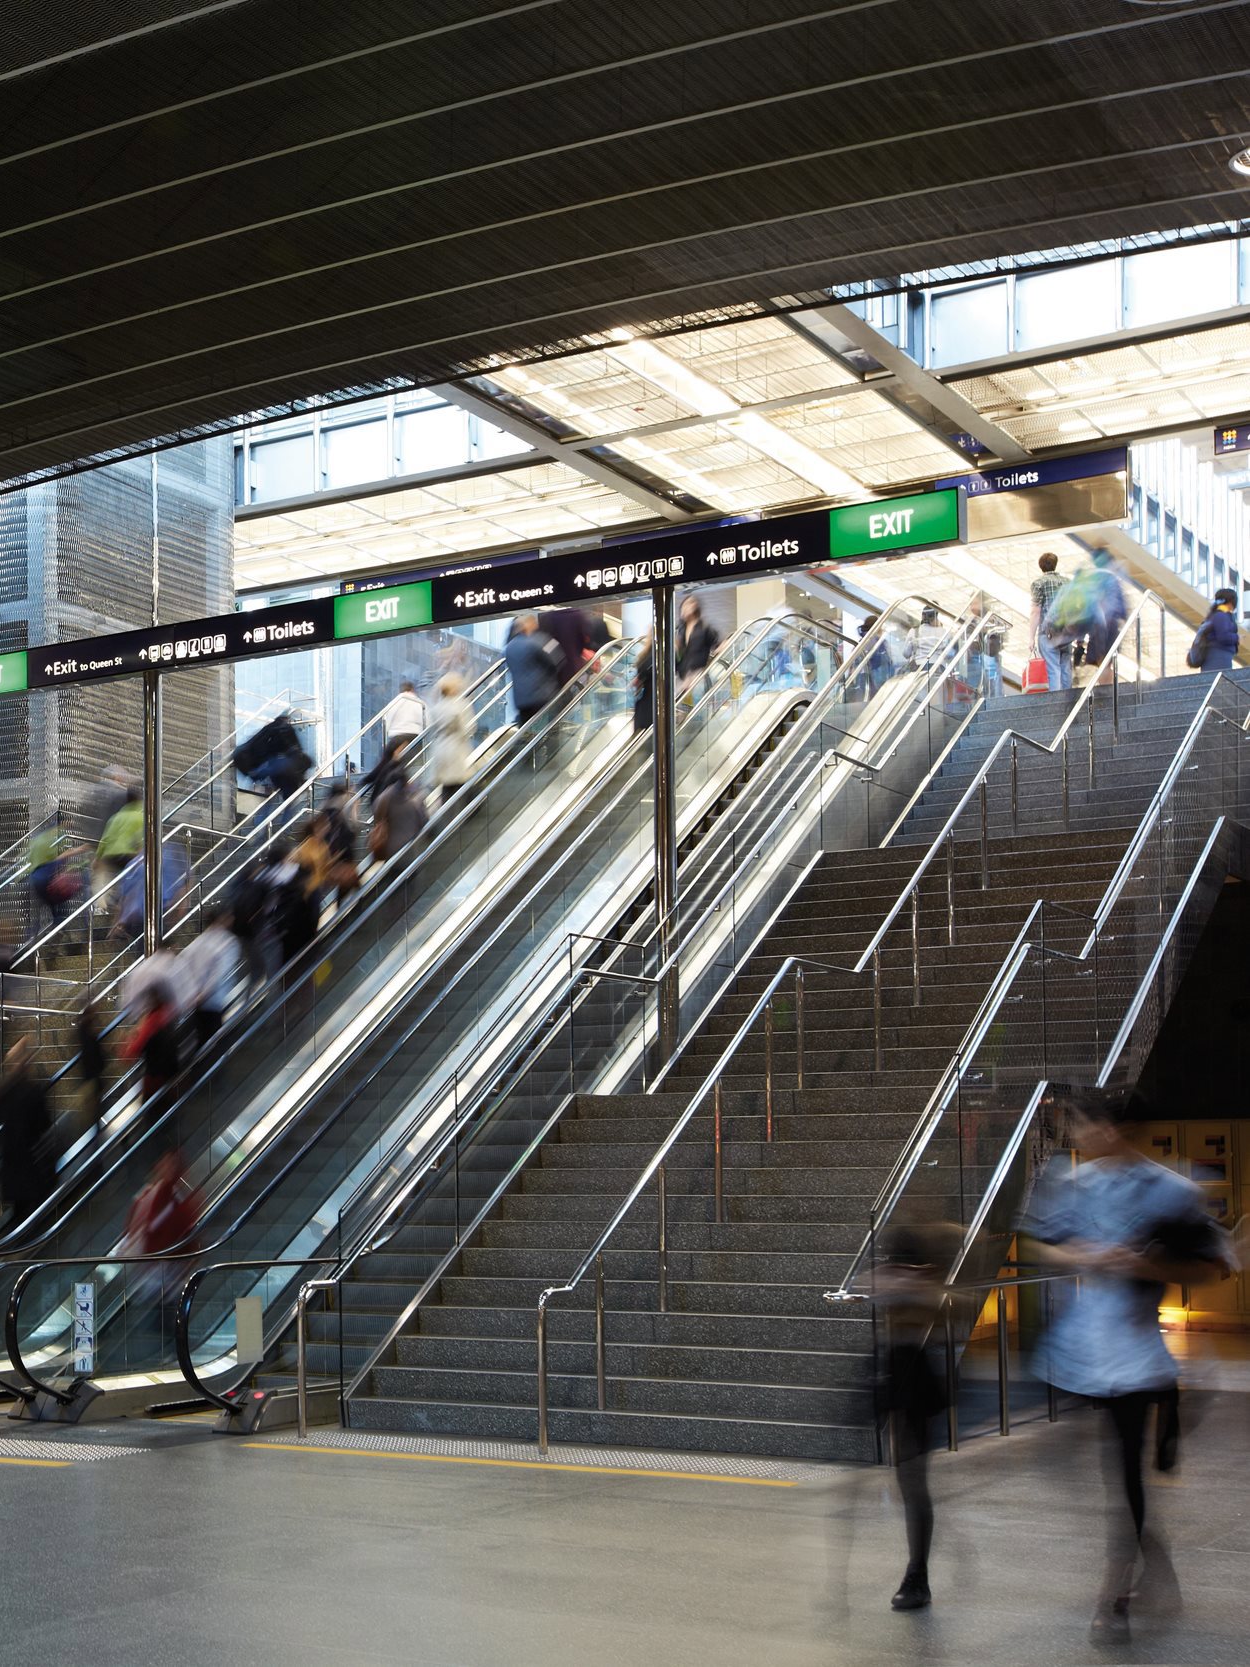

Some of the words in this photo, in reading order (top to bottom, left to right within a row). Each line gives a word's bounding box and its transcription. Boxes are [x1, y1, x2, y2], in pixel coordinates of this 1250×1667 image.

[995, 471, 1039, 488] Toilets
[869, 508, 914, 539] EXIT
[738, 538, 799, 562] Toilets
[465, 588, 496, 608] Exit
[499, 592, 510, 602] to
[511, 587, 542, 601] Queen
[543, 584, 554, 595] St
[365, 596, 400, 623] EXIT
[266, 620, 315, 641] Toilets
[53, 658, 77, 676] Exit
[79, 663, 88, 671] to
[89, 659, 113, 671] Queen
[114, 656, 123, 666] St
